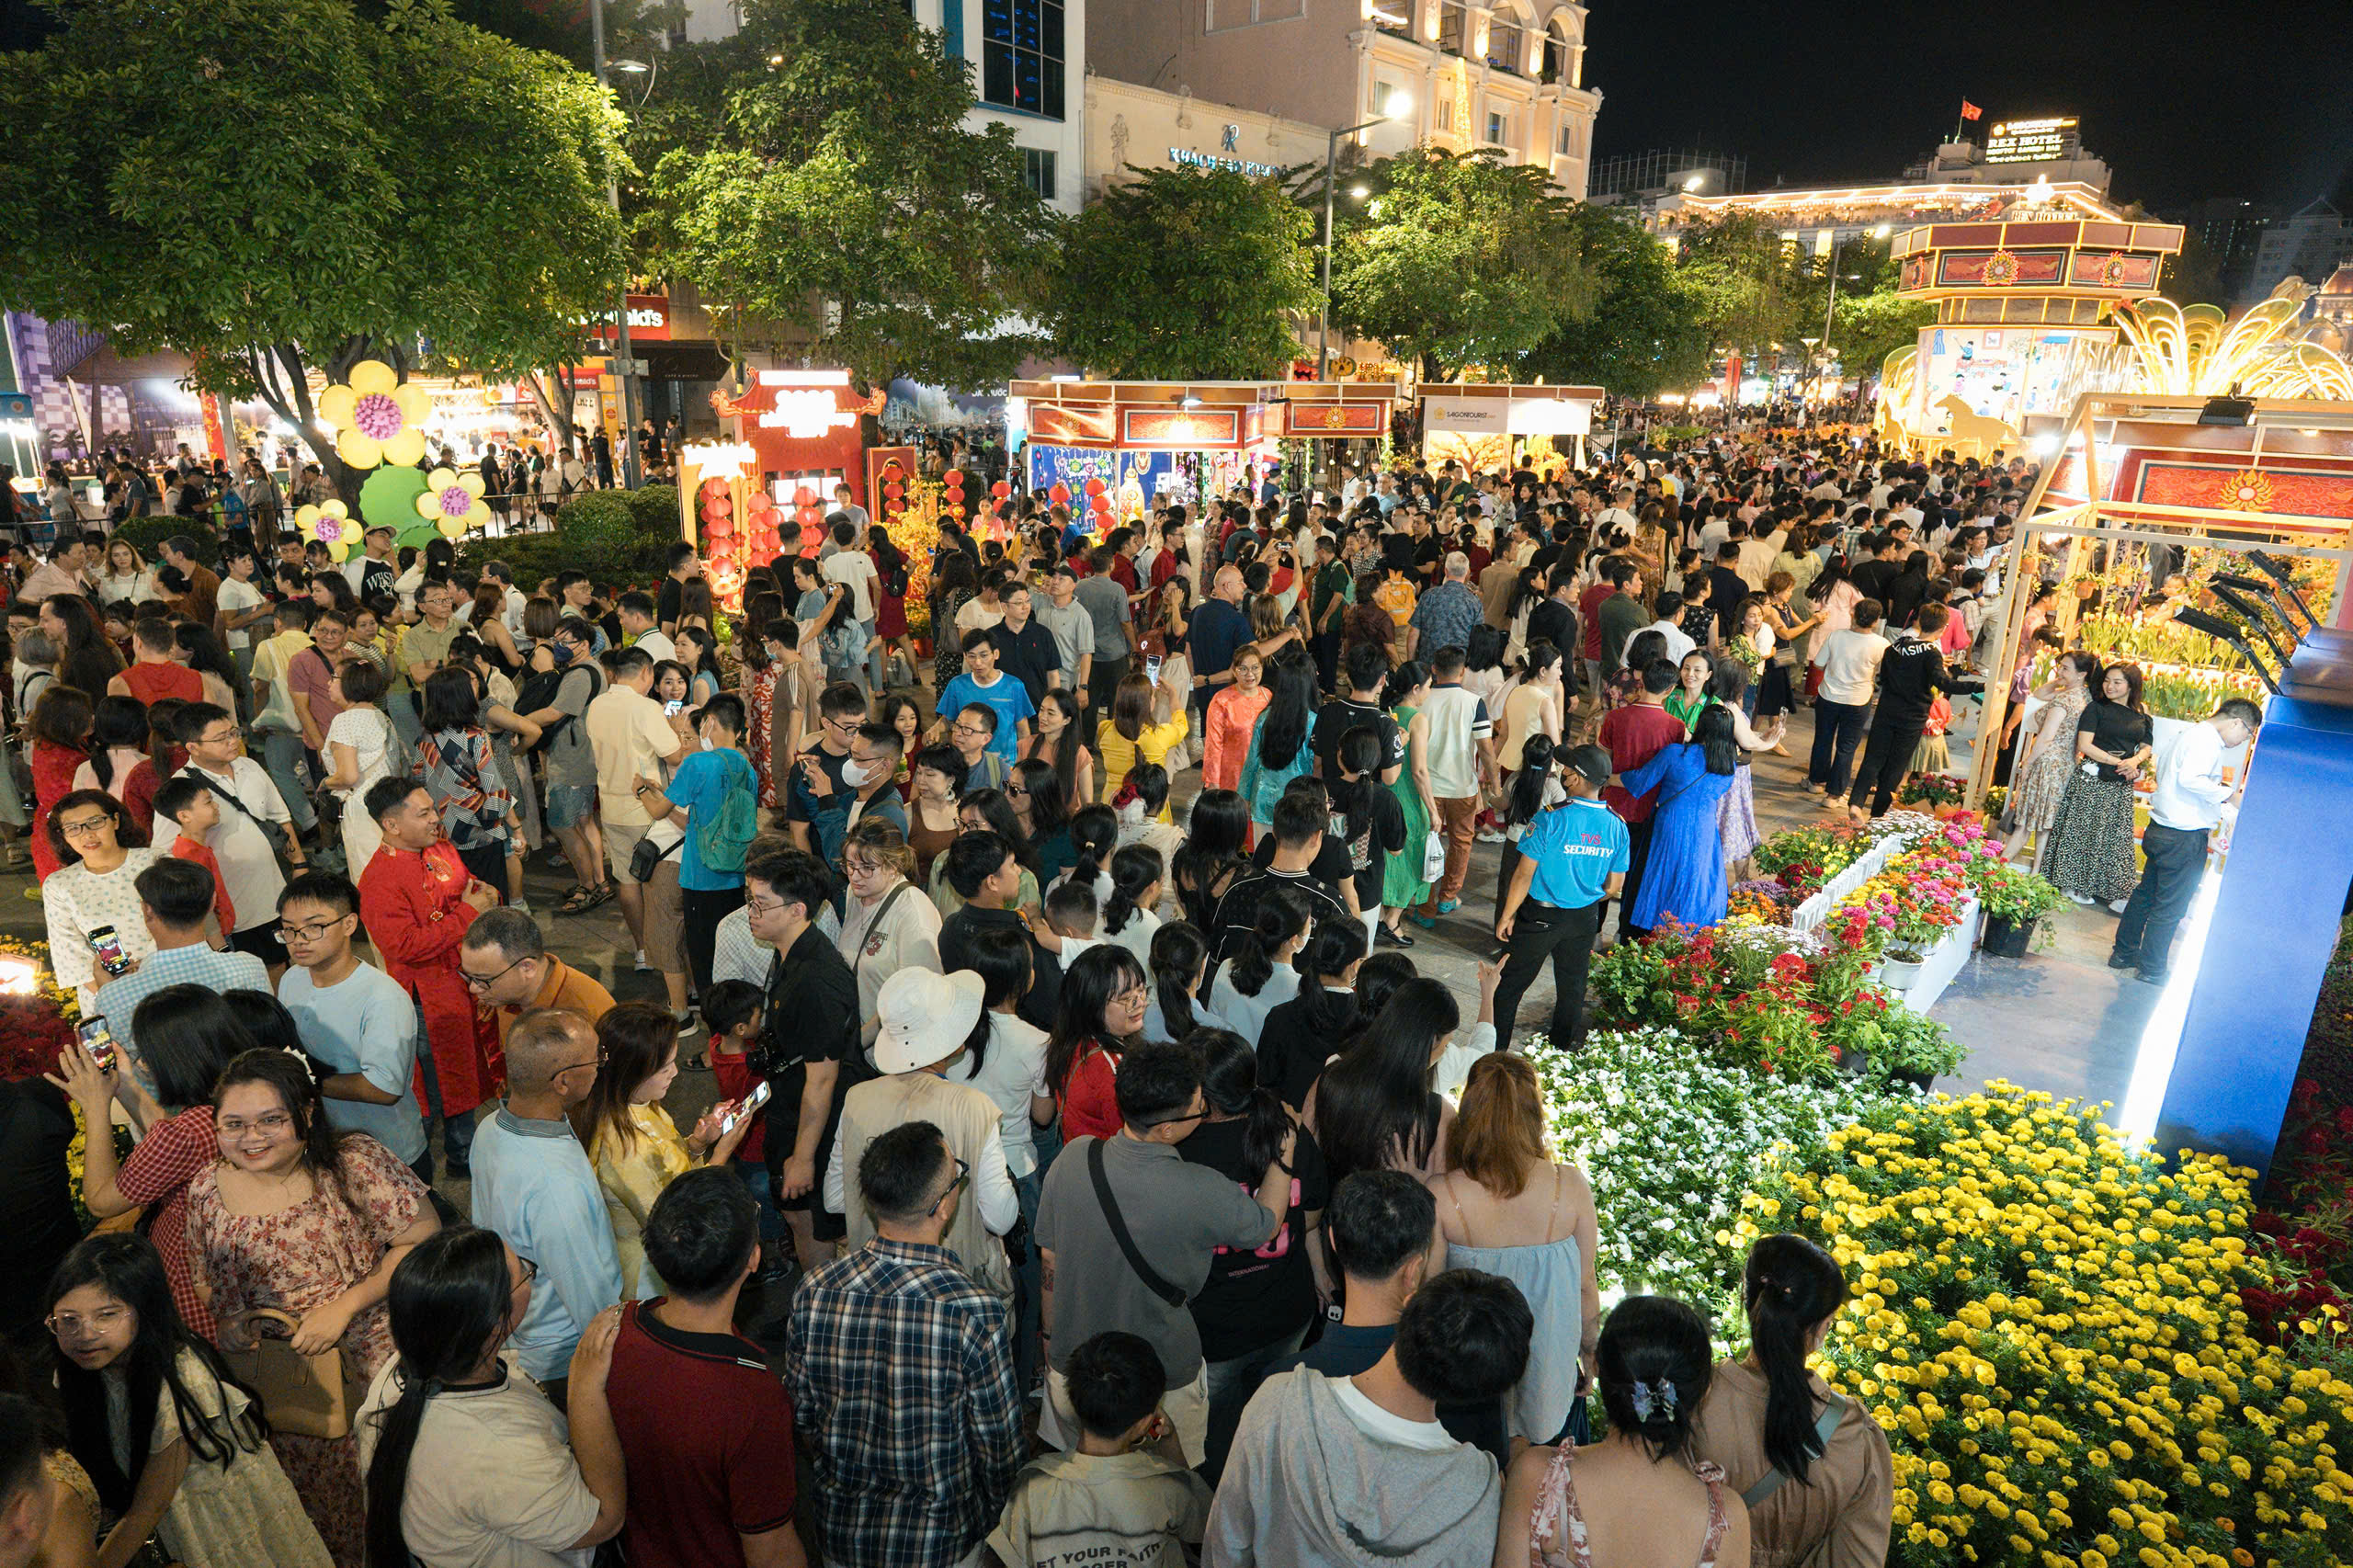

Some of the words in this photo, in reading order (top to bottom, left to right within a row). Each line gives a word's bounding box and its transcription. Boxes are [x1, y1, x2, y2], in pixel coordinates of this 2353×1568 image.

[1988, 138, 2018, 149] REX
[2019, 135, 2063, 146] HOTEL
[1581, 833, 1601, 845] TVS
[1563, 845, 1613, 858] SECURITY
[1063, 1546, 1111, 1563] YOUR
